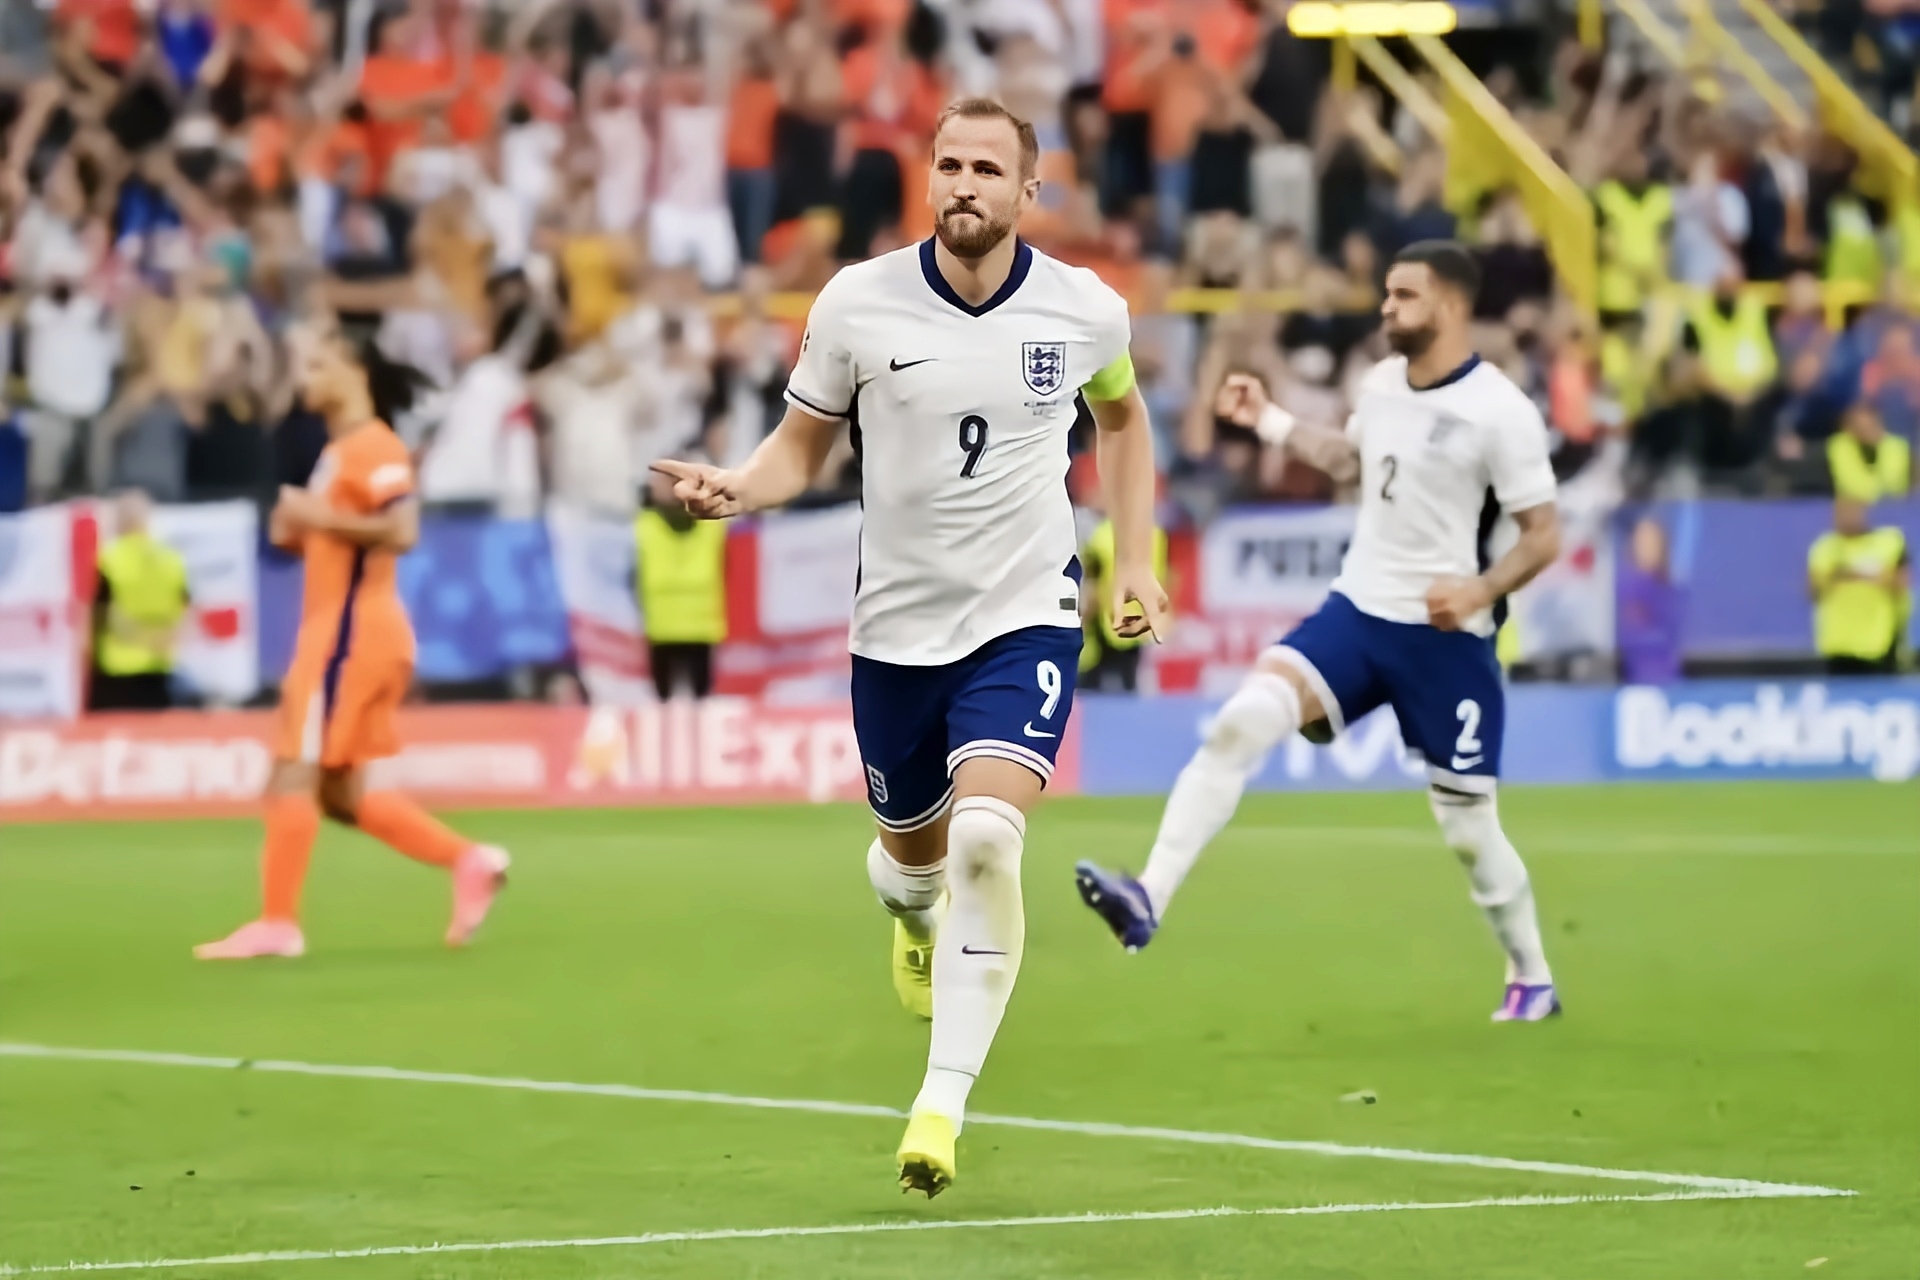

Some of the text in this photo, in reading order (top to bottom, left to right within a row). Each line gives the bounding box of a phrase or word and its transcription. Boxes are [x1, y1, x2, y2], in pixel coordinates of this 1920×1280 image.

[959, 414, 988, 479] 9
[1380, 454, 1397, 501] 2
[1036, 659, 1062, 720] 9
[1455, 698, 1482, 754] 2
[1615, 682, 1919, 782] Booking
